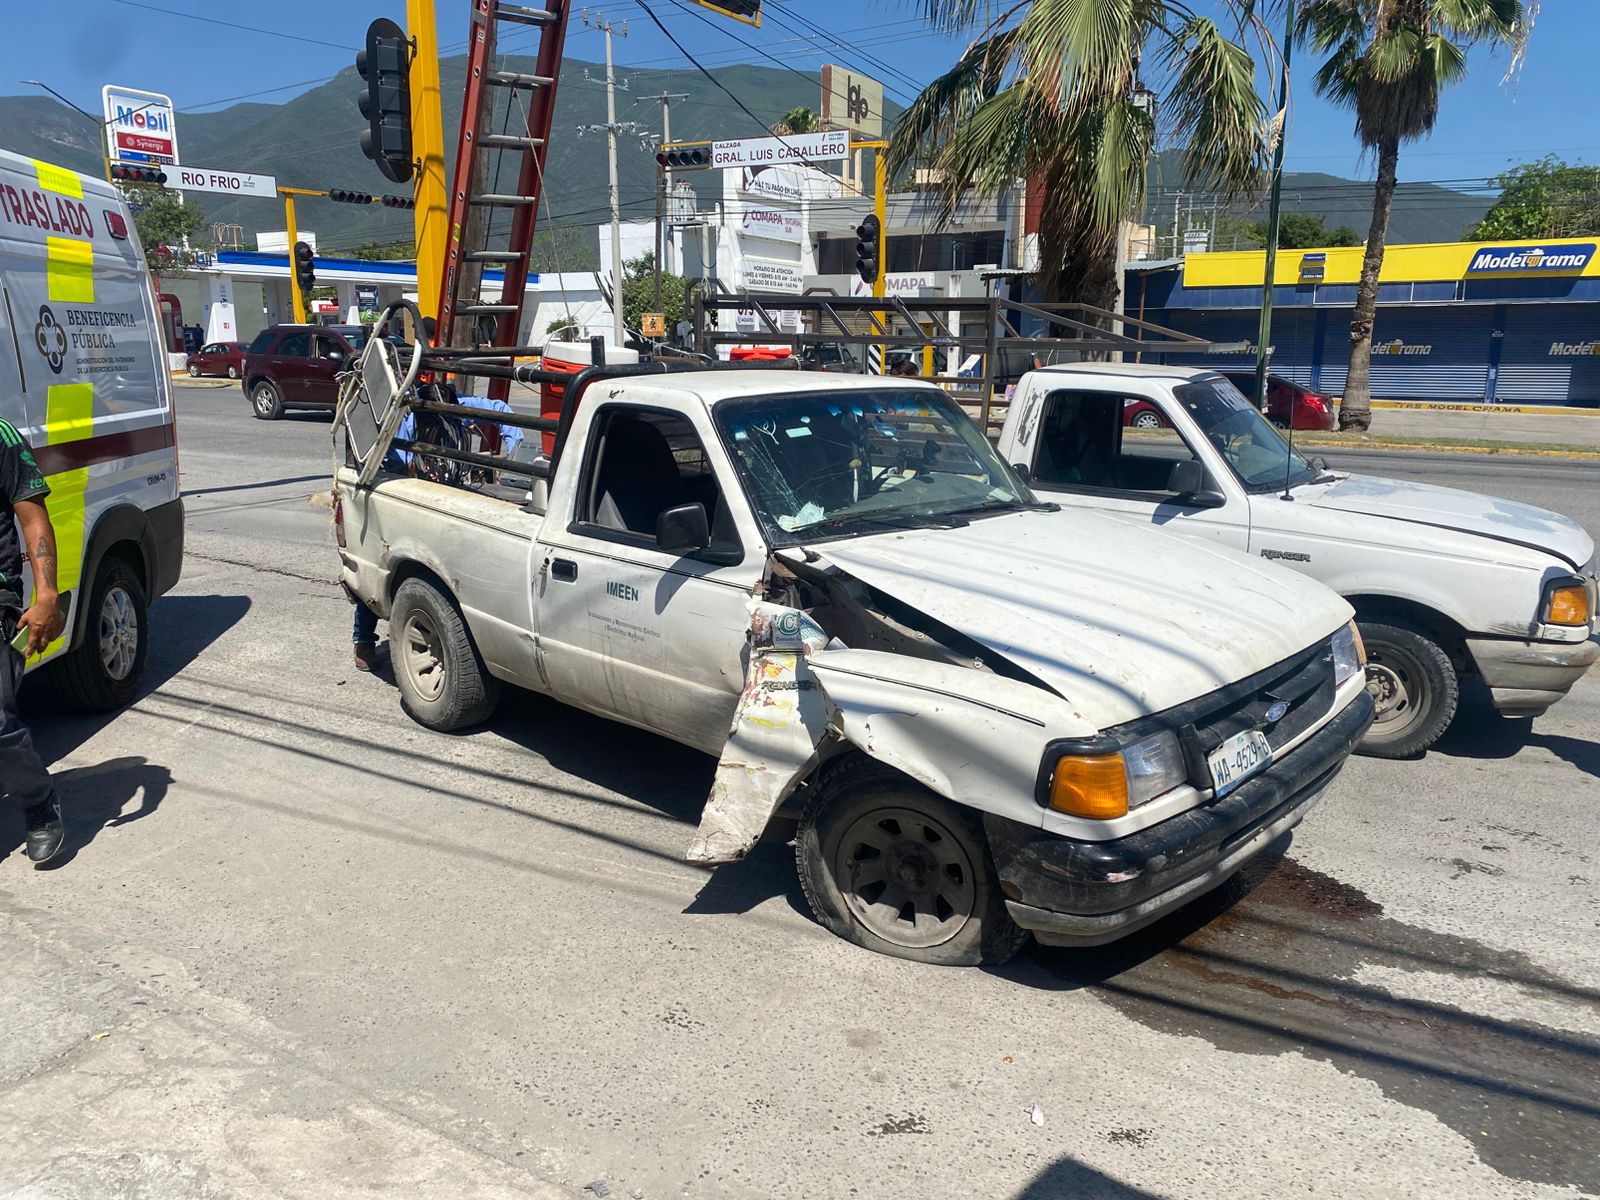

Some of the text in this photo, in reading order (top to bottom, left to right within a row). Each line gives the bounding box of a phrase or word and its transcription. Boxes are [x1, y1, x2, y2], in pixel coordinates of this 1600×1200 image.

[117, 105, 168, 132] Mobil
[136, 138, 163, 151] Synergy
[715, 143, 846, 163] GRAL. LUIS CABALLERO
[182, 172, 205, 186] RIO
[210, 175, 240, 190] FRIO
[771, 184, 783, 193] PAGO
[0, 183, 94, 238] TRASLADO
[751, 210, 783, 225] COMAPA
[66, 309, 137, 327] BENEFICENCIA
[71, 328, 116, 348] PÚBLICA
[1370, 341, 1432, 355] delorama
[1261, 549, 1311, 562] RANGER
[607, 582, 639, 601] IMEEN
[761, 681, 816, 692] RANGER
[1213, 733, 1269, 785] WA-4529-B
